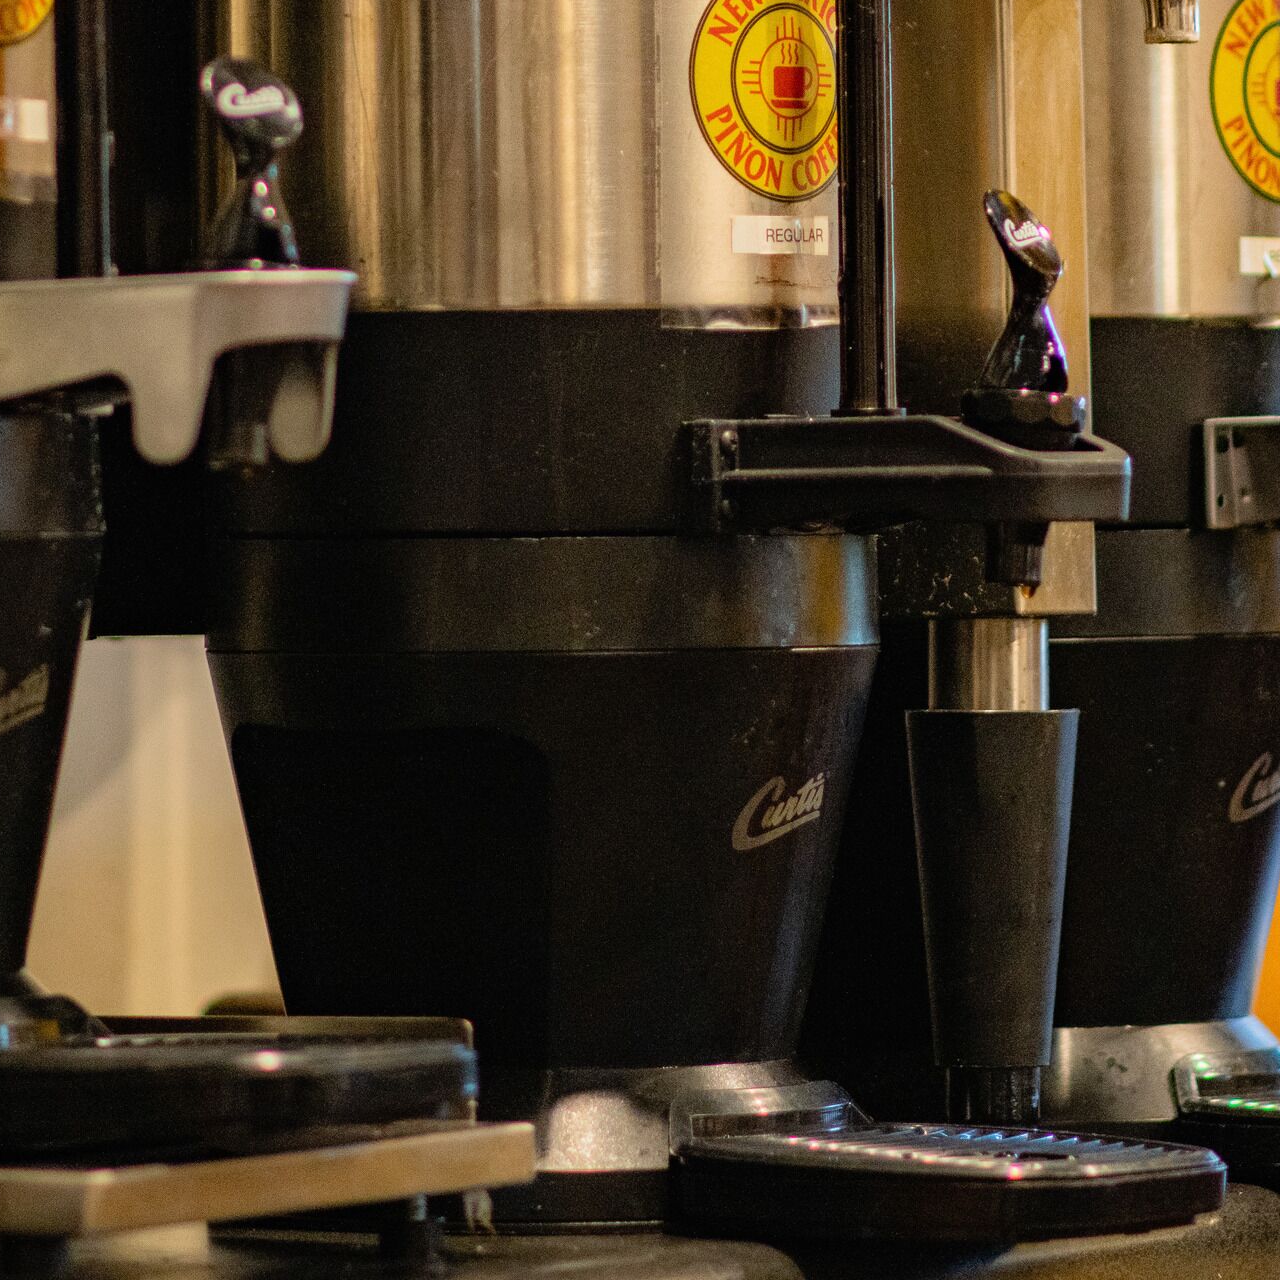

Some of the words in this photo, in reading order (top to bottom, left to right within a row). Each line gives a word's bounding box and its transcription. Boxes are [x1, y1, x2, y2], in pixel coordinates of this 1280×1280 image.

[705, 103, 785, 193] PIÑON
[791, 122, 838, 192] COFF
[765, 227, 824, 243] REGULAR
[732, 771, 826, 851] Curtis
